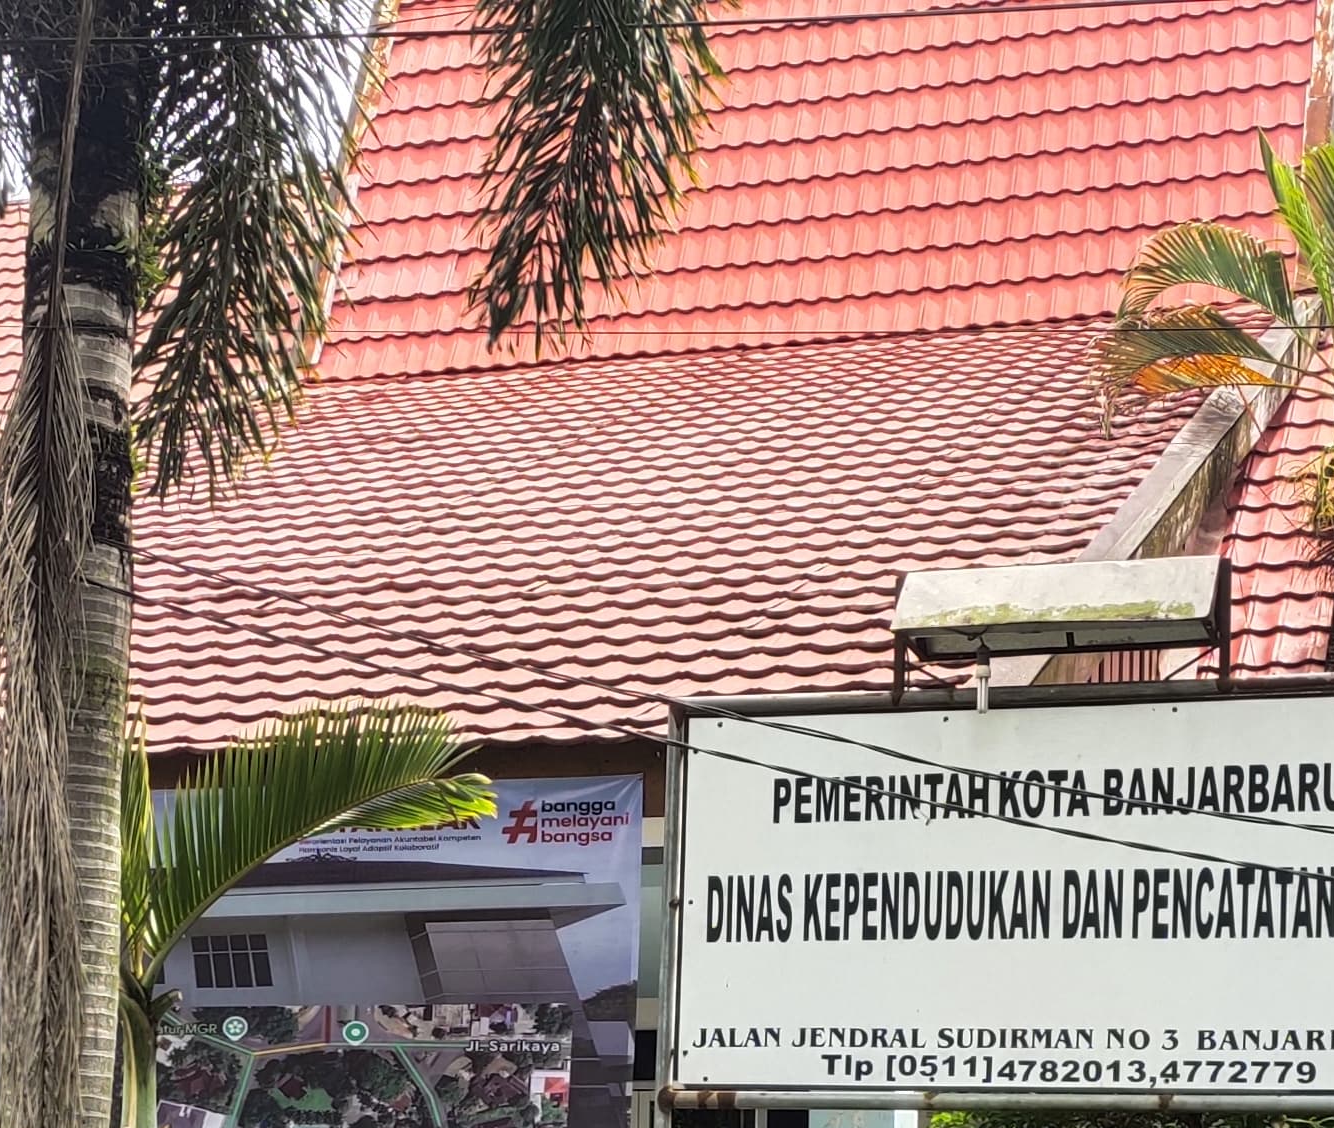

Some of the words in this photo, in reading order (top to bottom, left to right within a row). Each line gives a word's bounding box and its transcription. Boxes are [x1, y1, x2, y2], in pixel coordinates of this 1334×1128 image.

[772, 773, 991, 824] PEMERINTAH
[998, 769, 1090, 819] KOTA
[541, 799, 616, 816] bangga
[541, 813, 631, 831] melayani
[541, 829, 614, 846] bangsa
[706, 872, 793, 943] DINAS
[803, 869, 1052, 942] KEPENDUDUKAN
[1062, 868, 1124, 939] DAN
[185, 1023, 218, 1034] MGR
[465, 1040, 485, 1052] Jl.
[489, 1038, 560, 1054] Sarikaya
[692, 1027, 782, 1048] JALAN
[791, 1027, 928, 1049] JENDRAL
[937, 1027, 1094, 1050] SUDIRMAN
[1106, 1028, 1151, 1050] NO
[1161, 1029, 1180, 1051] 3
[821, 1053, 875, 1081] Tlp
